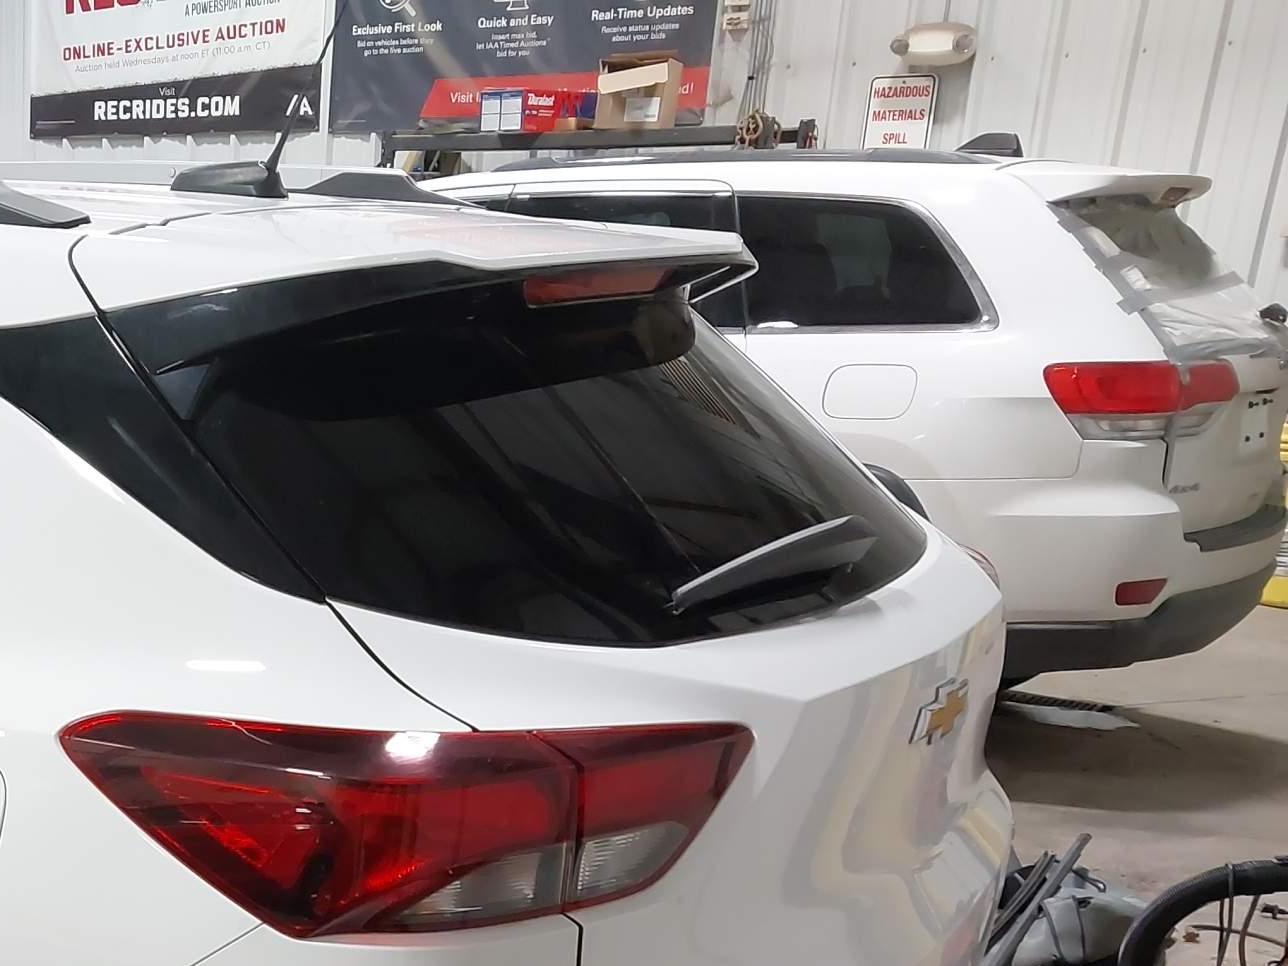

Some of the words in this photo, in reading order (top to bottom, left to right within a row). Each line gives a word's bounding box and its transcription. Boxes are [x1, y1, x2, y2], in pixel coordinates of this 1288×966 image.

[592, 8, 644, 20] Real-Time
[647, 5, 695, 19] Updates
[352, 24, 392, 36] Exclusive
[394, 22, 415, 32] First
[418, 20, 443, 32] Look
[477, 17, 508, 28] Quick
[509, 15, 528, 26] and
[530, 14, 554, 26] Easy
[63, 29, 211, 61] ONLINE-EXCLUSIVE
[215, 18, 286, 41] AUCTION
[157, 87, 177, 96] Visit
[450, 91, 473, 104] Visit
[873, 85, 931, 99] HAZARDOUS
[93, 96, 241, 120] RECRIDES.COM
[872, 108, 926, 122] MATERIALS
[882, 132, 908, 145] SPILL
